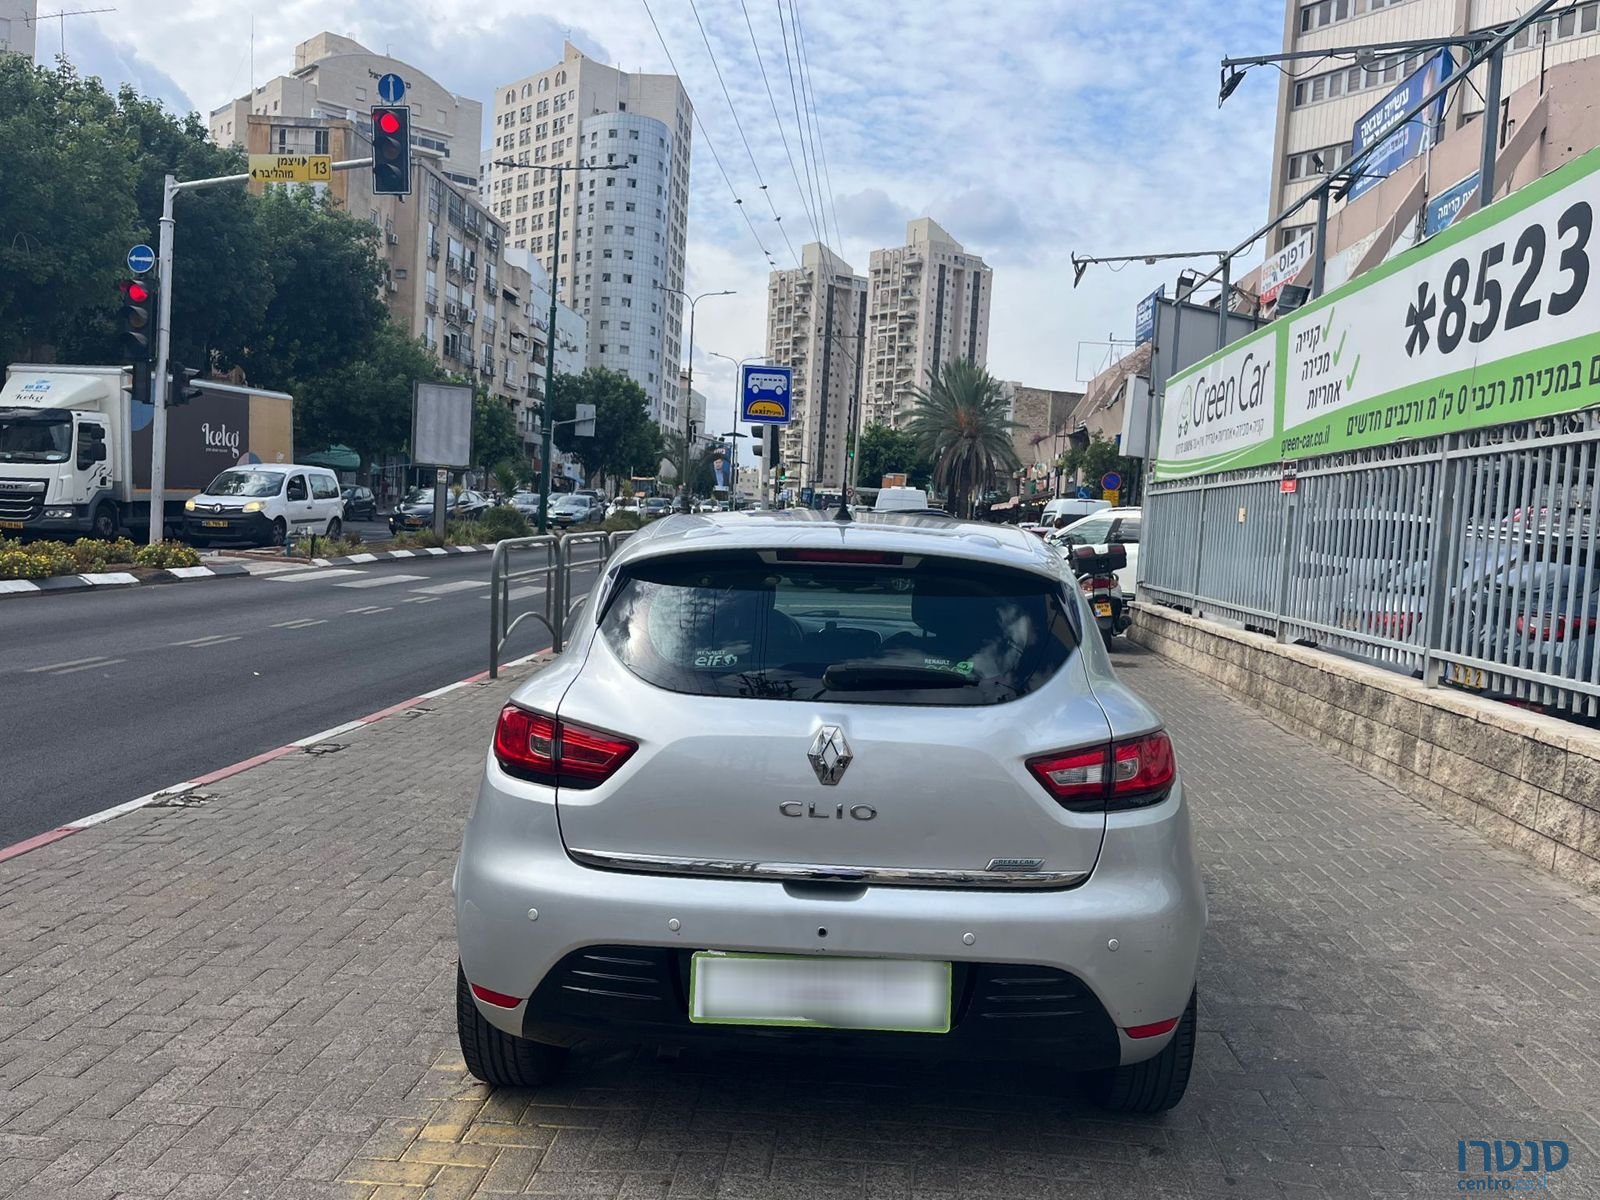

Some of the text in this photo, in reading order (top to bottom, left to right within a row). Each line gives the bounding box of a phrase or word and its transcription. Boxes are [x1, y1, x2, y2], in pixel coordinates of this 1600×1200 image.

[259, 167, 294, 178] מוהליבר
[277, 157, 300, 168] ויצמן
[313, 161, 327, 175] 13
[1280, 240, 1305, 273] דפוס
[1295, 325, 1321, 354] קנייה
[1301, 352, 1331, 381] מכירה
[1193, 352, 1271, 428] Green Car
[1307, 379, 1342, 410] אחריות
[1472, 380, 1506, 411] רכבי
[1509, 360, 1582, 404] במכירת
[1346, 409, 1382, 437] חדשים
[1384, 400, 1424, 428] ורכבים
[1281, 425, 1330, 457] green-car.co.il
[779, 800, 878, 820] CLIO
